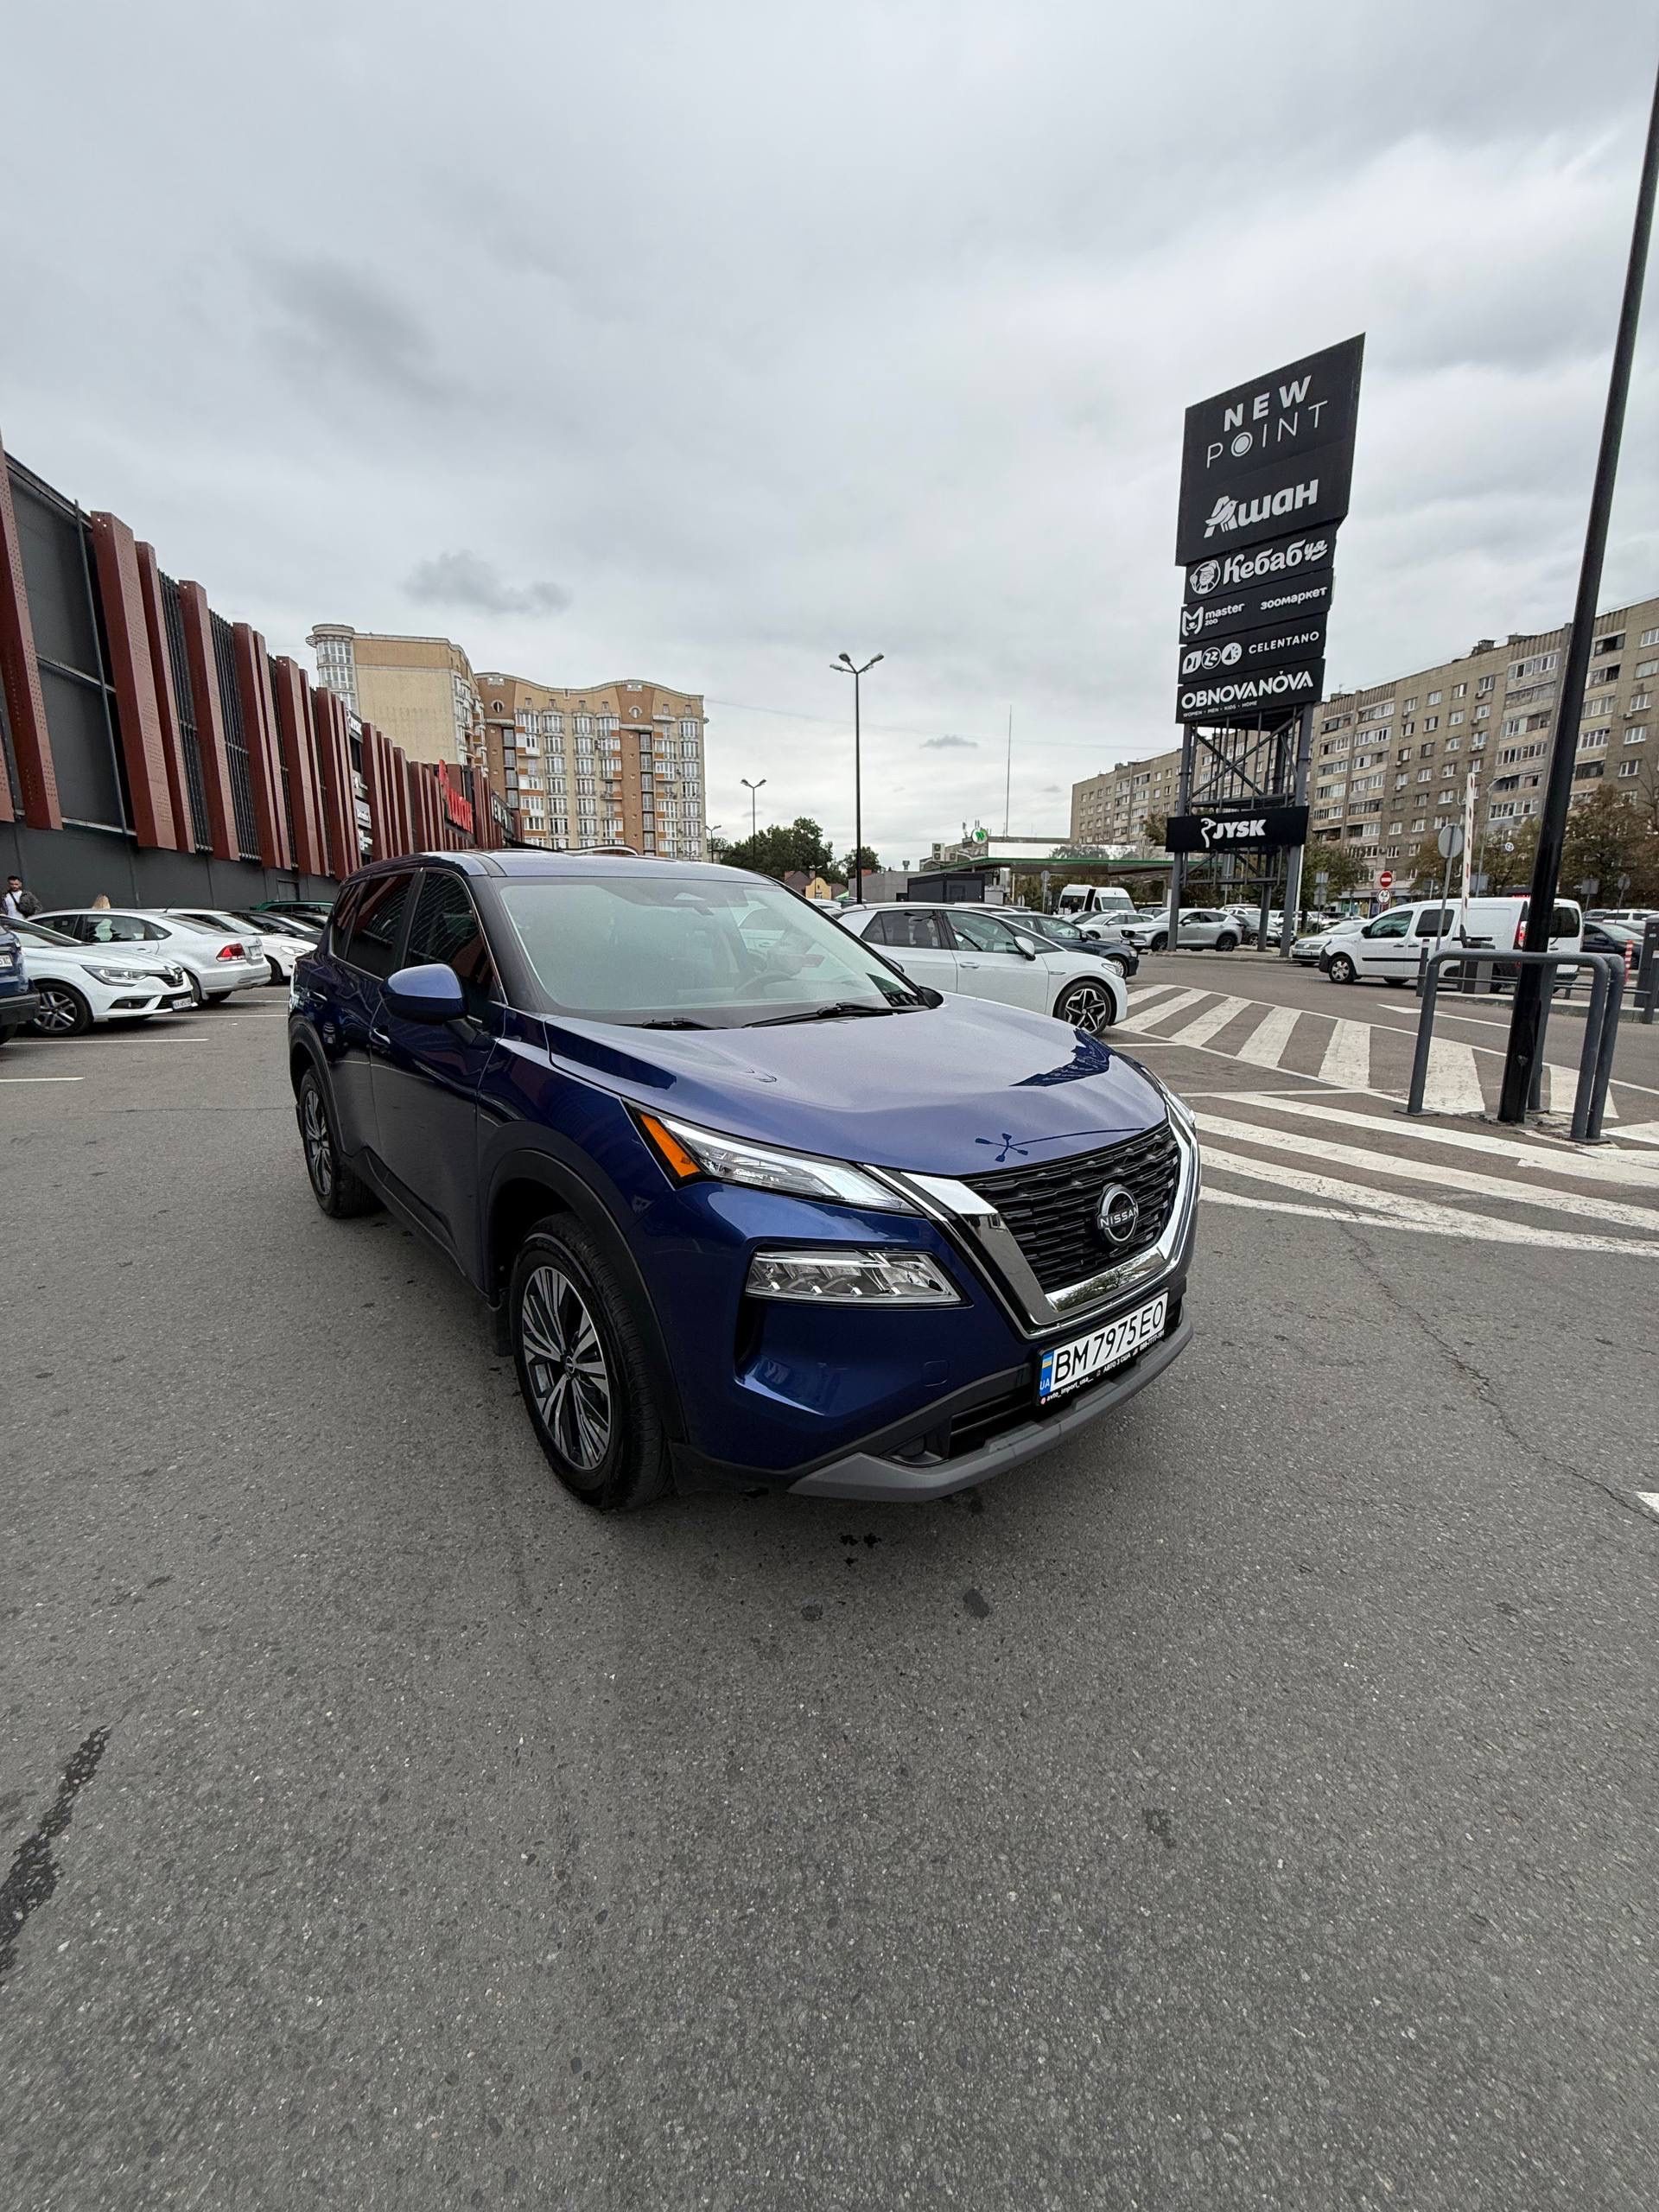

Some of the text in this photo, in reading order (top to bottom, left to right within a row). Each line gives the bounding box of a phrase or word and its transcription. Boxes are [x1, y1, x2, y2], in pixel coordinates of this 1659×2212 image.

[1224, 375, 1312, 432] NEW
[1206, 400, 1328, 468] POINT
[1204, 479, 1319, 538] Ашан
[1260, 587, 1328, 611] зоомаркет
[1205, 603, 1245, 620] master
[1248, 631, 1319, 654] CELENTANO
[1212, 819, 1267, 840] JYSK
[1100, 1202, 1139, 1227] NISSAN
[1039, 1379, 1050, 1390] UA
